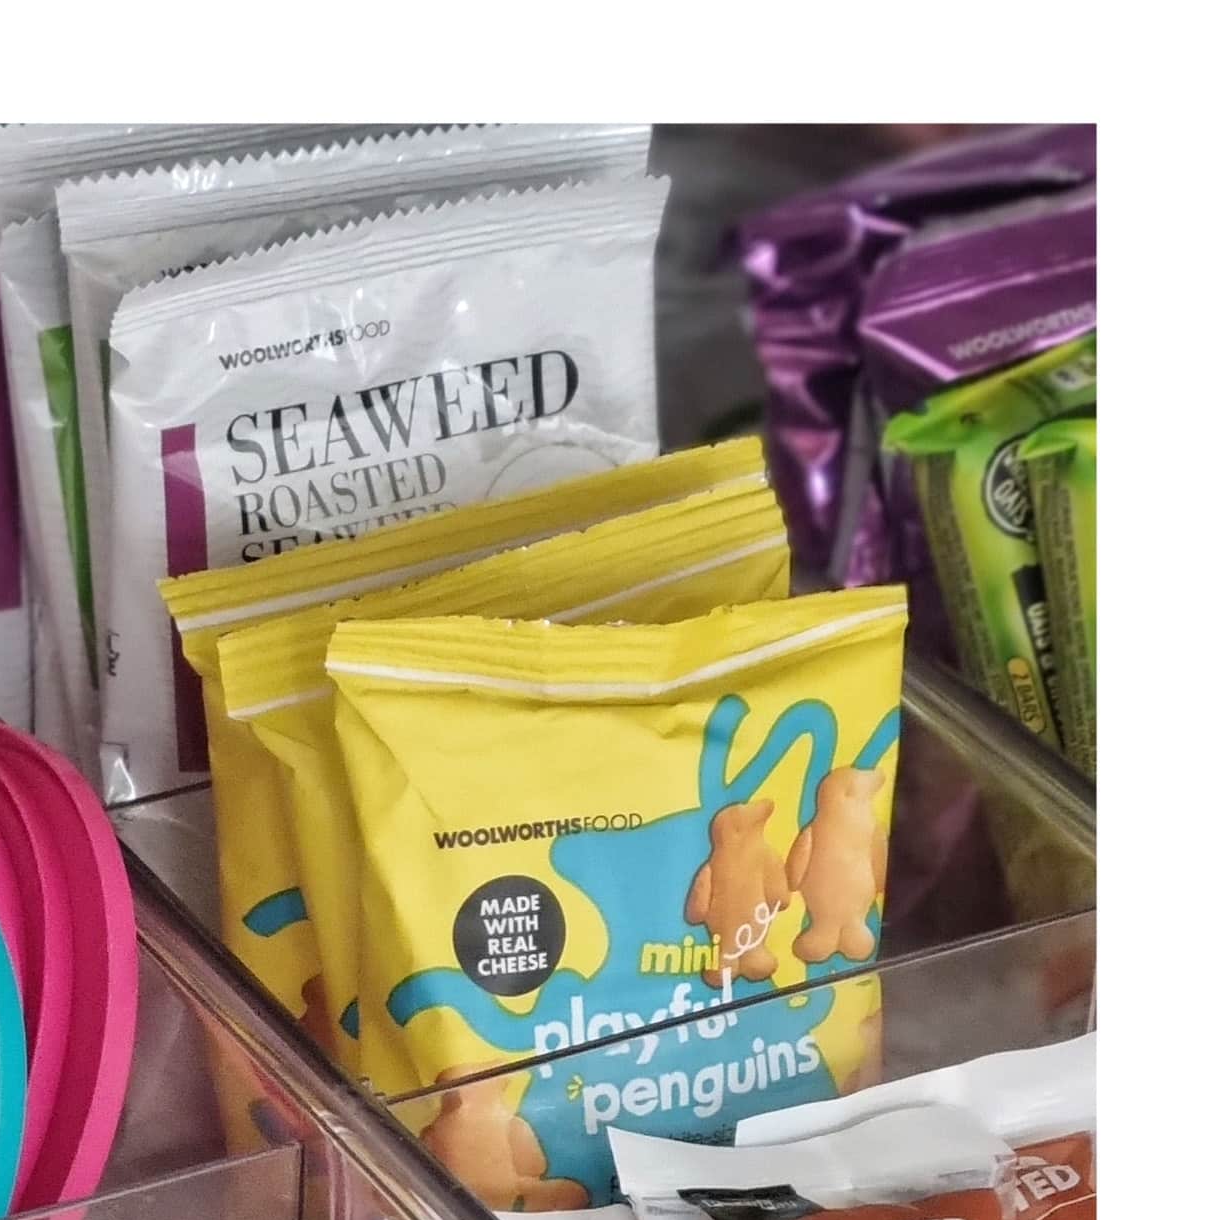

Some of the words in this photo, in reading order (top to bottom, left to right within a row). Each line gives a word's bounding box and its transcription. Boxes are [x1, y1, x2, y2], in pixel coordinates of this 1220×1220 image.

[226, 349, 580, 486] SEAWEED
[235, 452, 448, 537] ROASTED
[433, 812, 644, 850] WOOLWORTHSFOOD
[480, 894, 541, 917] MADE
[483, 914, 540, 936] WITH
[477, 952, 549, 977] CHEESE
[487, 935, 537, 956] REAL
[639, 933, 722, 975] mini
[533, 965, 741, 1080] playful
[581, 1034, 821, 1136] penguins
